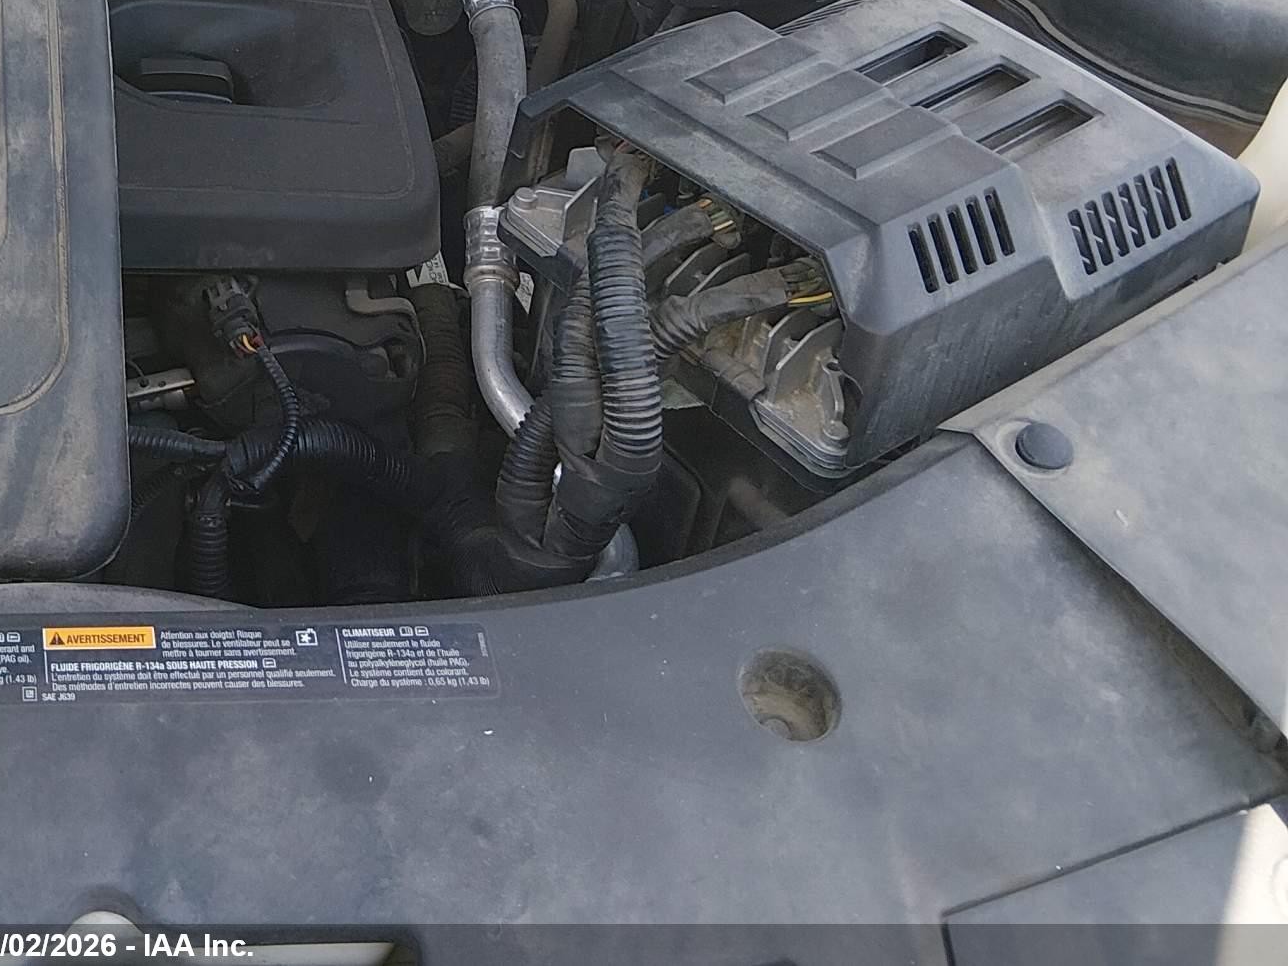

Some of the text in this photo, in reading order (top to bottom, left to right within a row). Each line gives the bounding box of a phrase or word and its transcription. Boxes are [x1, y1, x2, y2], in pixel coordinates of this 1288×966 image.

[160, 631, 193, 640] Attention
[194, 631, 208, 639] aux
[236, 630, 262, 640] Risque
[342, 628, 396, 637] CLIMATISEUR
[66, 634, 146, 644] AVERTISSEMENT
[161, 638, 291, 648] de blessures. Le ventilateur peut se
[344, 640, 369, 648] Utiliser
[371, 640, 410, 648] seulement
[420, 639, 441, 647] fluide
[20, 644, 35, 653] and
[162, 649, 187, 657] mettre
[188, 649, 194, 657] à
[195, 649, 222, 657] tourner
[243, 647, 297, 656] avertissement.
[17, 654, 32, 664] oil).
[50, 660, 258, 672] FLUIDE FRIGORIGÈNE R-134a SOUS HAUTE PRESSION
[5, 674, 26, 684] (1.43
[26, 674, 37, 684] lb)
[41, 692, 56, 701] SAE
[57, 692, 76, 701] J639
